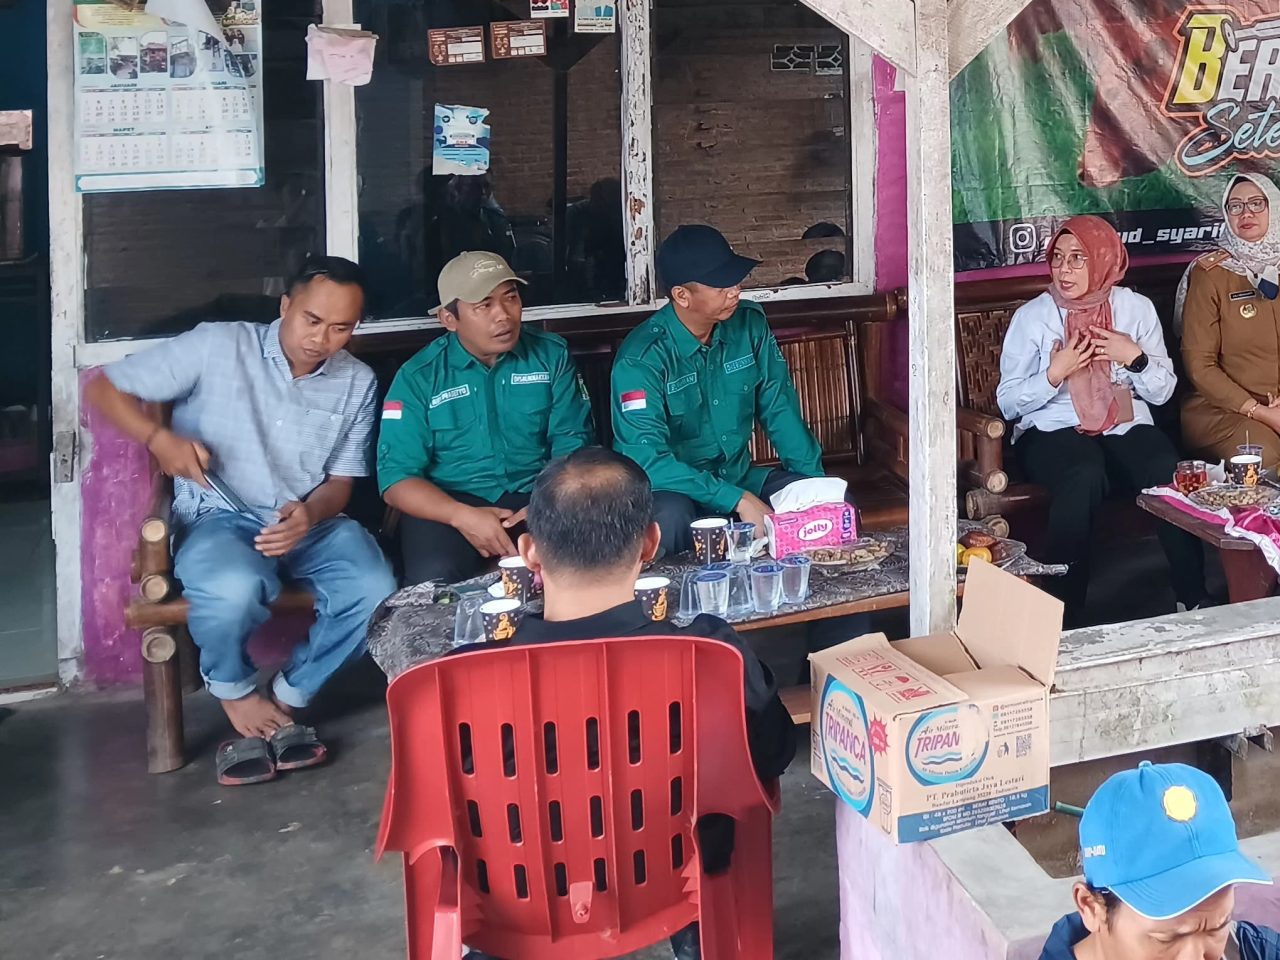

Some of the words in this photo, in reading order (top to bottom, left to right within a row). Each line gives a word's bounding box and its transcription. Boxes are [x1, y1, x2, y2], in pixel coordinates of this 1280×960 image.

[803, 522, 828, 538] jolly
[825, 711, 866, 766] TRIPANCA
[981, 782, 998, 793] Jaya
[1000, 776, 1025, 789] Lestari
